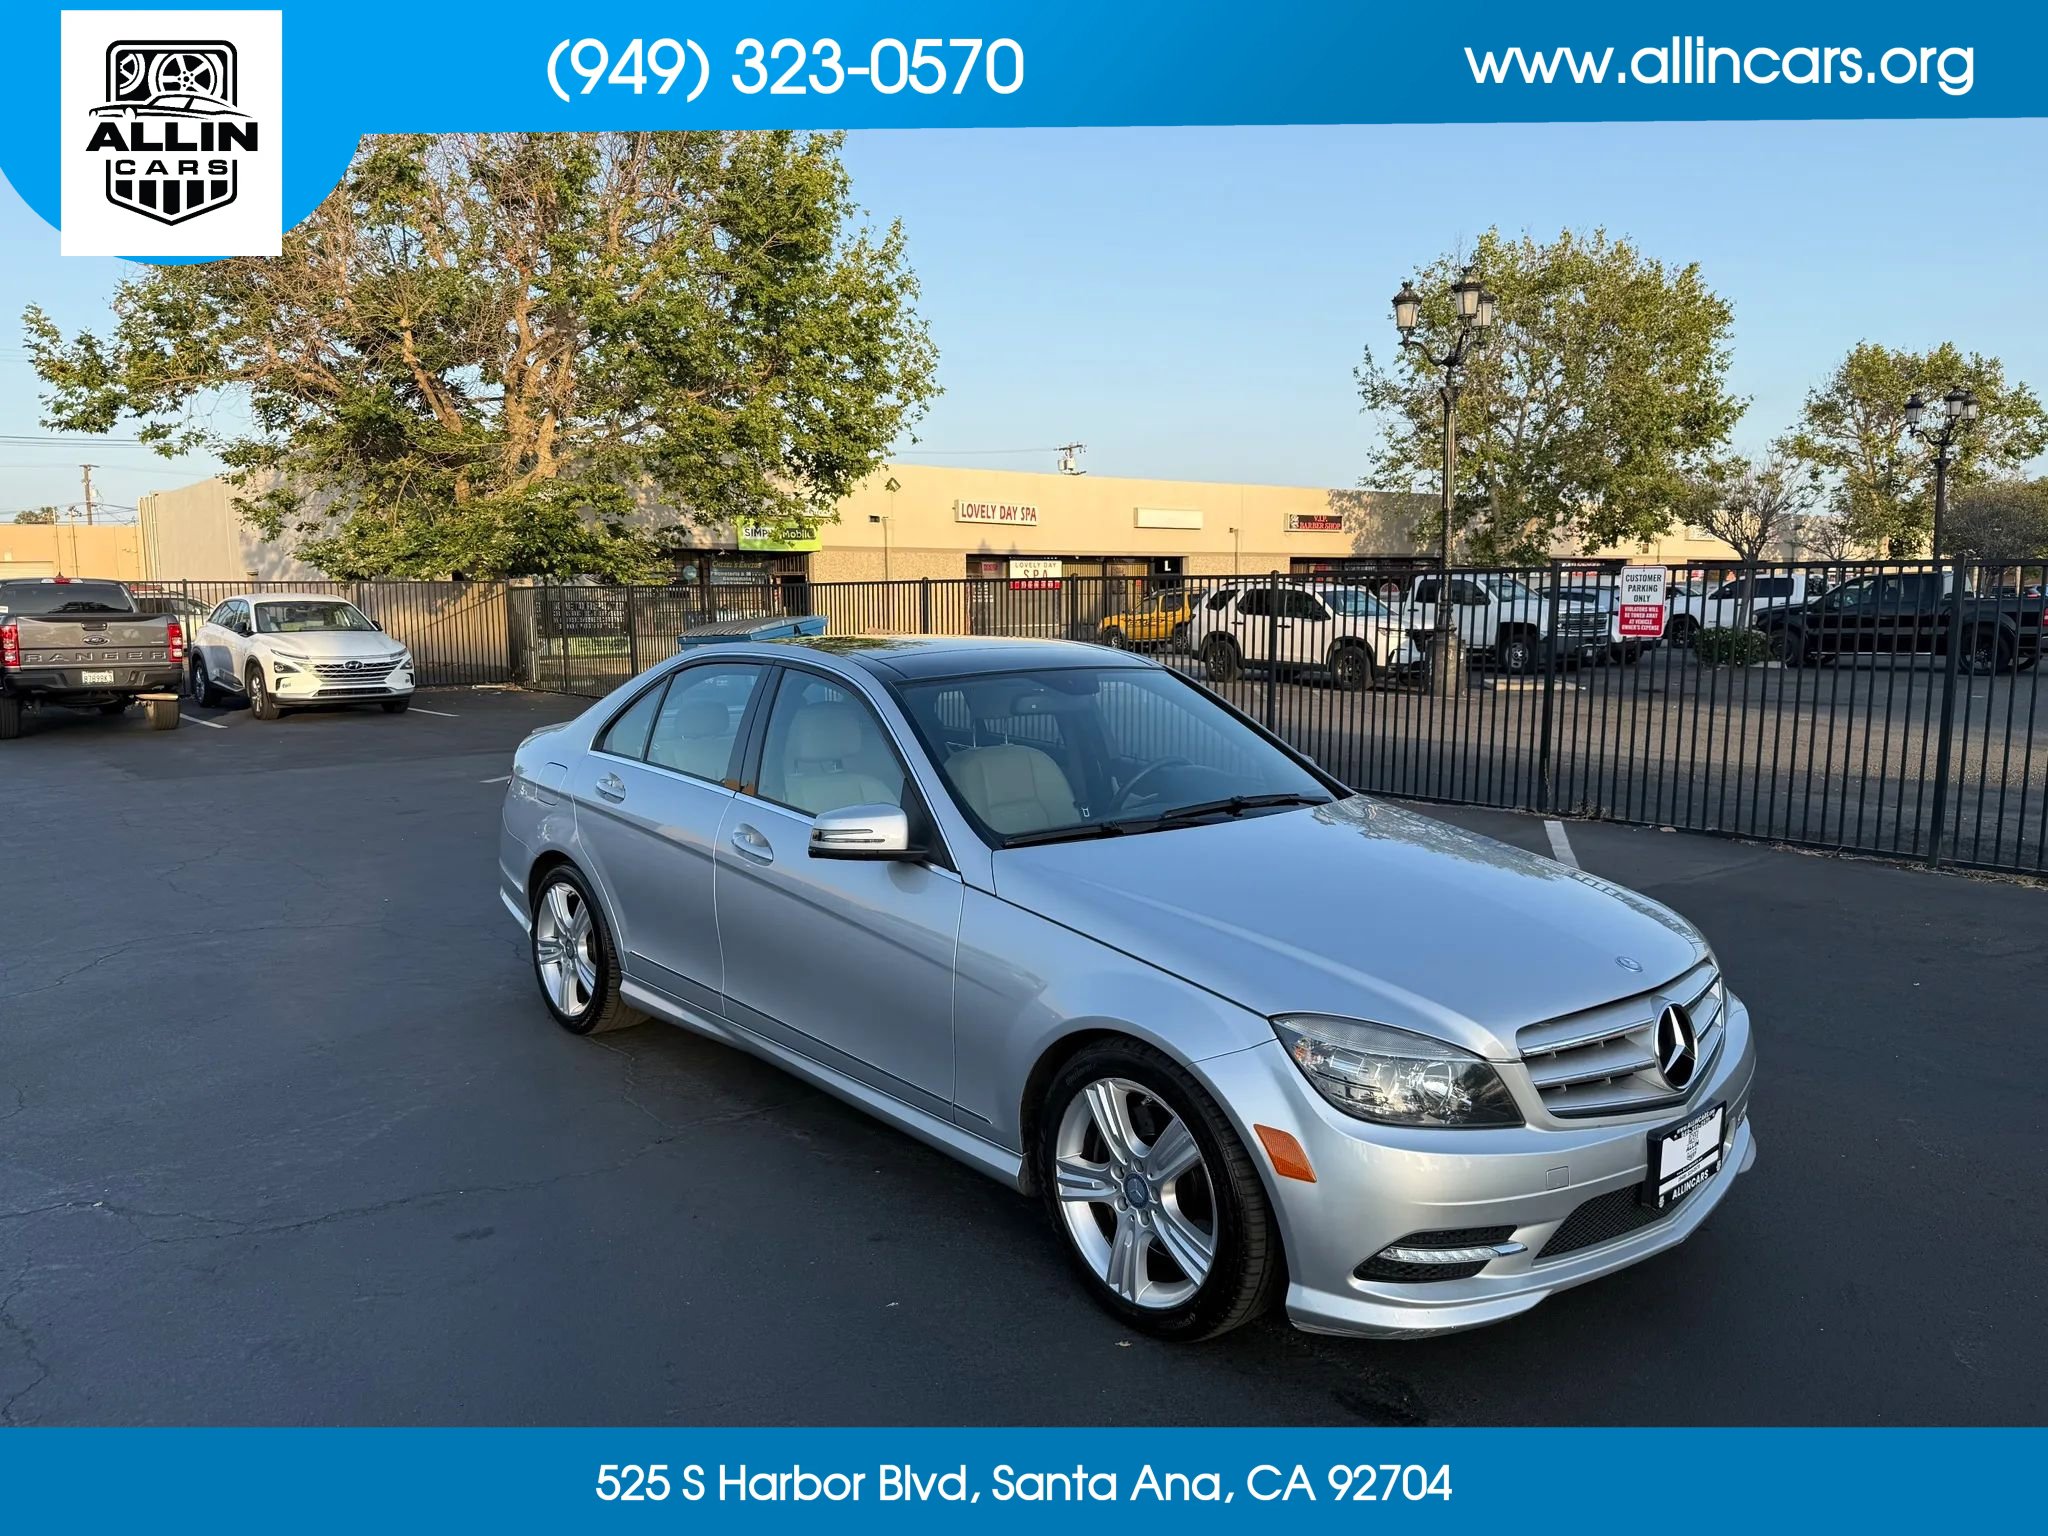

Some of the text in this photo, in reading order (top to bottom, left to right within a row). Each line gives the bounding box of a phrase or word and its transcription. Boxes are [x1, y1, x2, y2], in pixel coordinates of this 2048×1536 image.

[961, 503, 1036, 521] LOVELY DAY SPA
[1164, 560, 1171, 571] L
[1023, 569, 1048, 578] SPA
[1625, 574, 1661, 582] CUSTOMER
[1628, 584, 1658, 592] PARKING
[24, 651, 167, 662] RANGER
[1672, 1169, 1709, 1200] ALLINCARS
